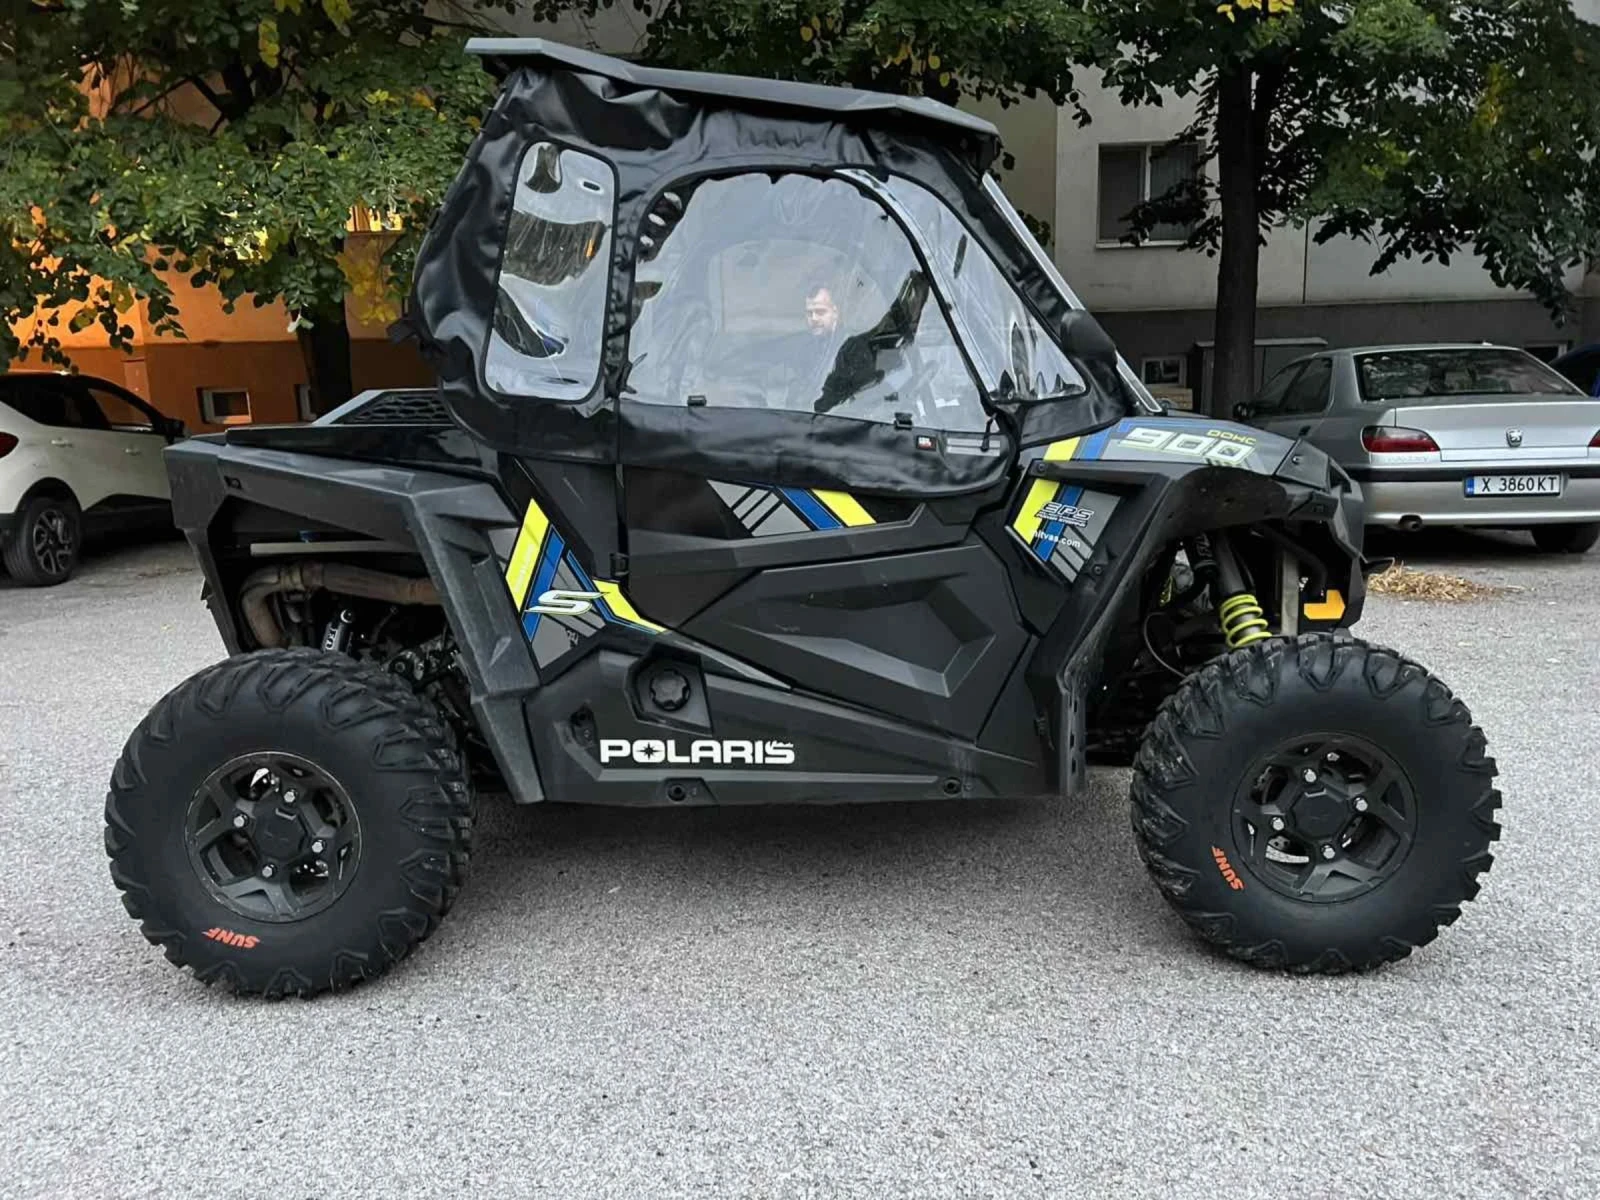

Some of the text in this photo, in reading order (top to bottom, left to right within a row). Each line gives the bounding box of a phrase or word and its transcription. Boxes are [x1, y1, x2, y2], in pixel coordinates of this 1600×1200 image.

[1118, 427, 1255, 466] 900
[1207, 429, 1256, 445] DOHC
[1481, 477, 1491, 492] X
[1043, 501, 1095, 521] EPS
[524, 589, 609, 616] S
[600, 739, 795, 764] POLARIS
[1212, 845, 1244, 890] SUNF
[201, 927, 261, 949] SUNF
